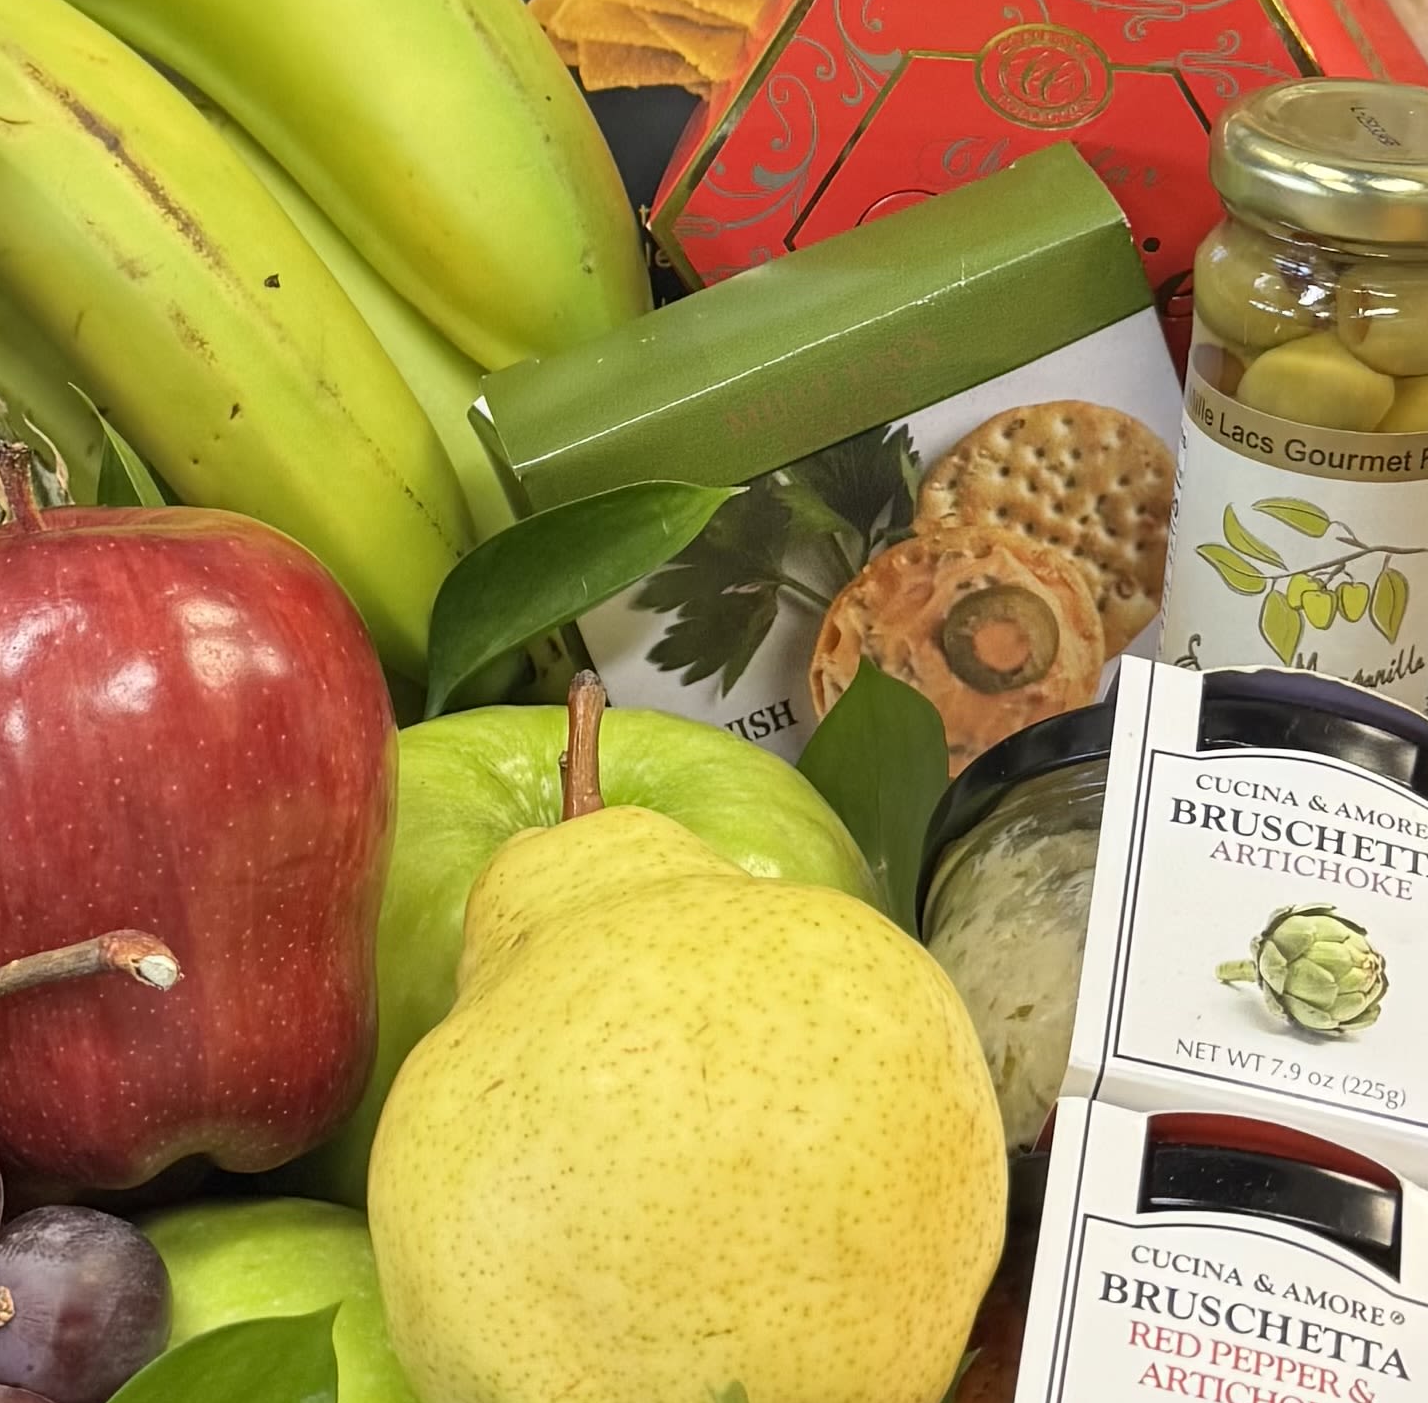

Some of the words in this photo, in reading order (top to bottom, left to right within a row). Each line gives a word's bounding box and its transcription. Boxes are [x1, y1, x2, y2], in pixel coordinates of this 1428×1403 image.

[1220, 412, 1274, 454] Lacs
[1285, 438, 1412, 472] Gourmet
[724, 698, 799, 741] ISH
[1195, 773, 1299, 808] CUCINA
[1308, 794, 1329, 814] &
[1209, 840, 1413, 901] ARTICHOKE
[1175, 1038, 1220, 1062] NET
[1227, 1048, 1265, 1072] WT
[1271, 1058, 1302, 1080] 7.9
[1308, 1071, 1335, 1090] oz
[1341, 1074, 1406, 1110] (225g)
[1131, 1245, 1243, 1287] CUCINA
[1253, 1273, 1276, 1296] &
[1098, 1270, 1411, 1382] BRUSCHETTA
[1128, 1319, 1202, 1359] RED
[1209, 1338, 1341, 1398] PEPPER
